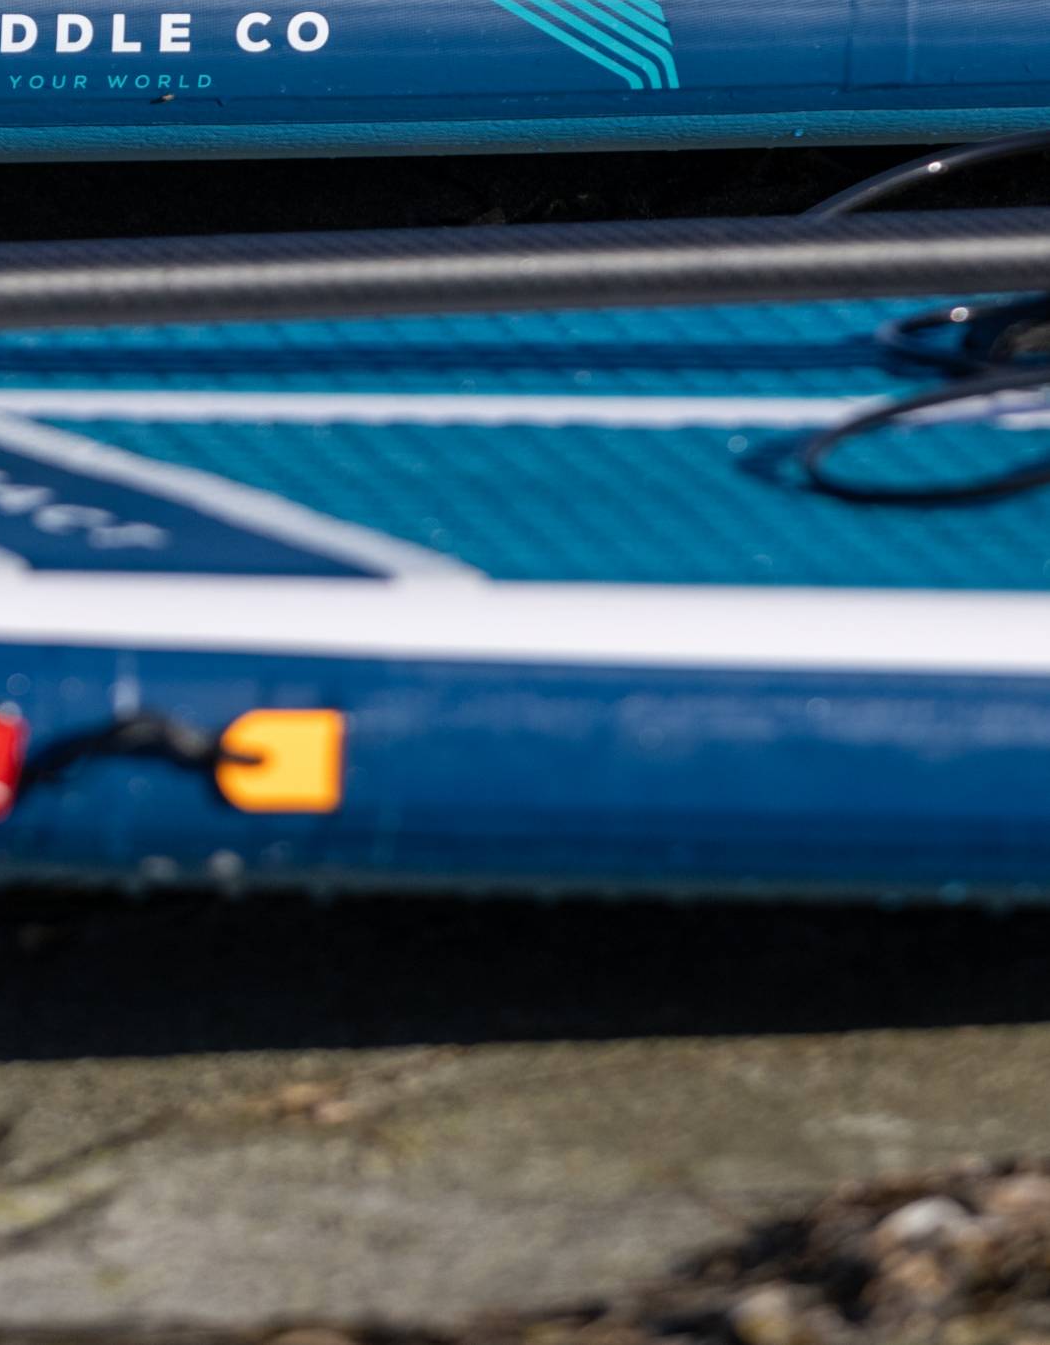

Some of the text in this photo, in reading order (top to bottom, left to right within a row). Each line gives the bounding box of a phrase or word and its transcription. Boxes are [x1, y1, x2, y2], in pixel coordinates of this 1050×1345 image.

[235, 11, 330, 53] CO
[8, 74, 88, 90] YOUR
[107, 73, 212, 90] WORLD
